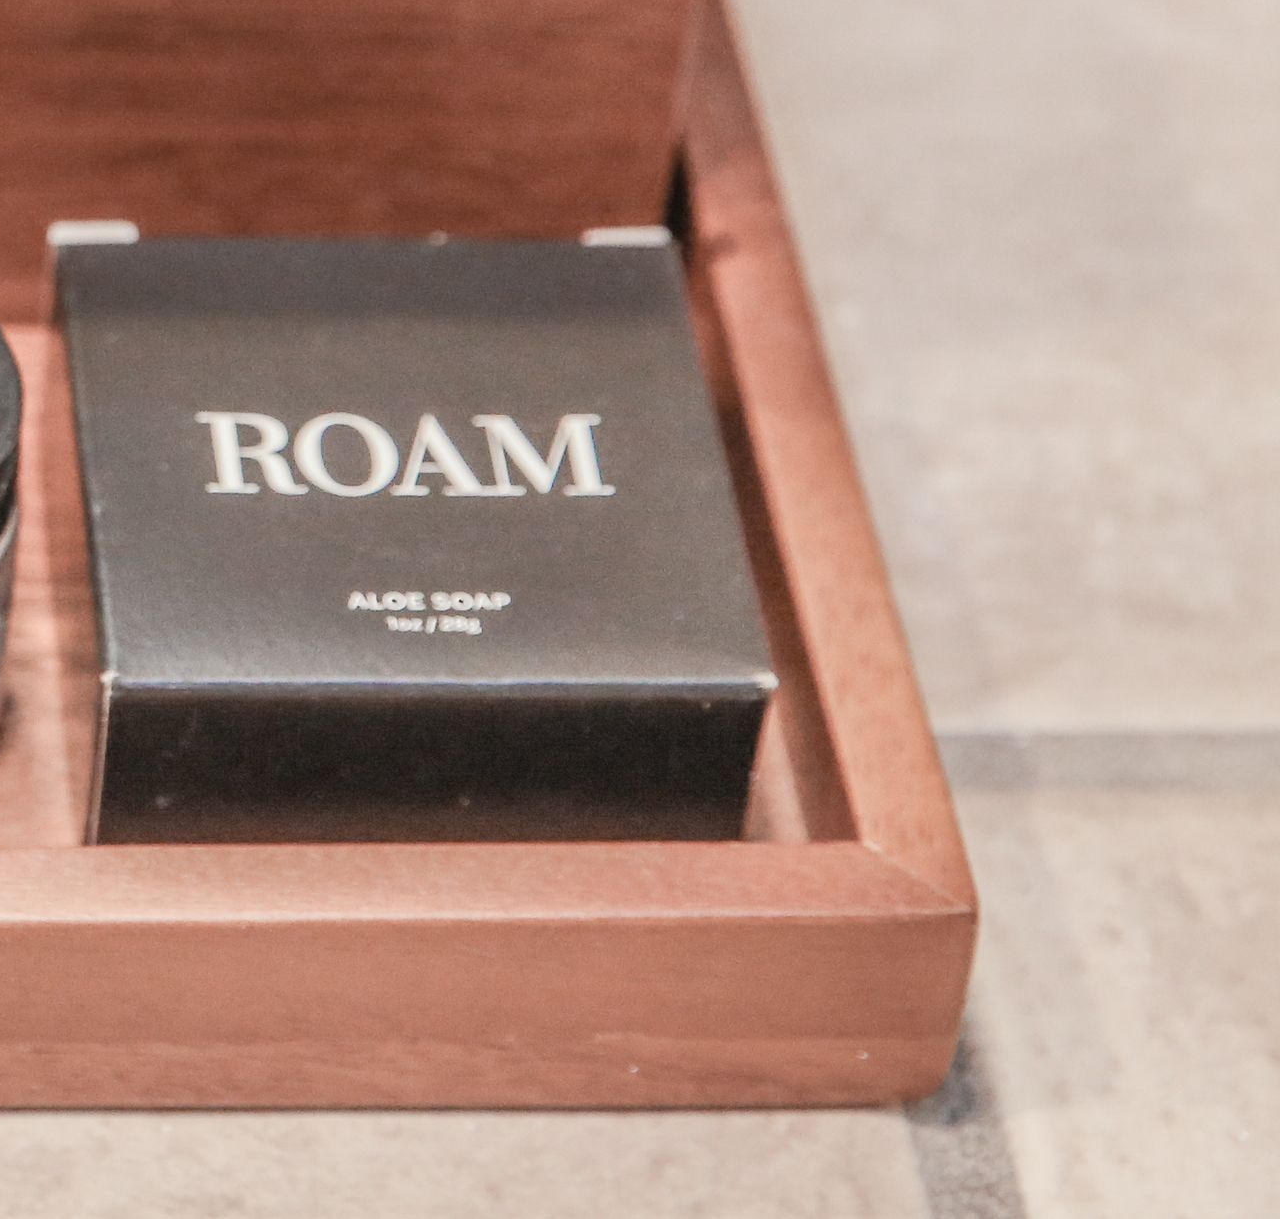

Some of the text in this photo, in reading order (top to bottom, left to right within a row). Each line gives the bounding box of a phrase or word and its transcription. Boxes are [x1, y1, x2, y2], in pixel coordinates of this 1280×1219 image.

[194, 410, 616, 497] ROAM
[347, 590, 512, 611] ALOE SOAP
